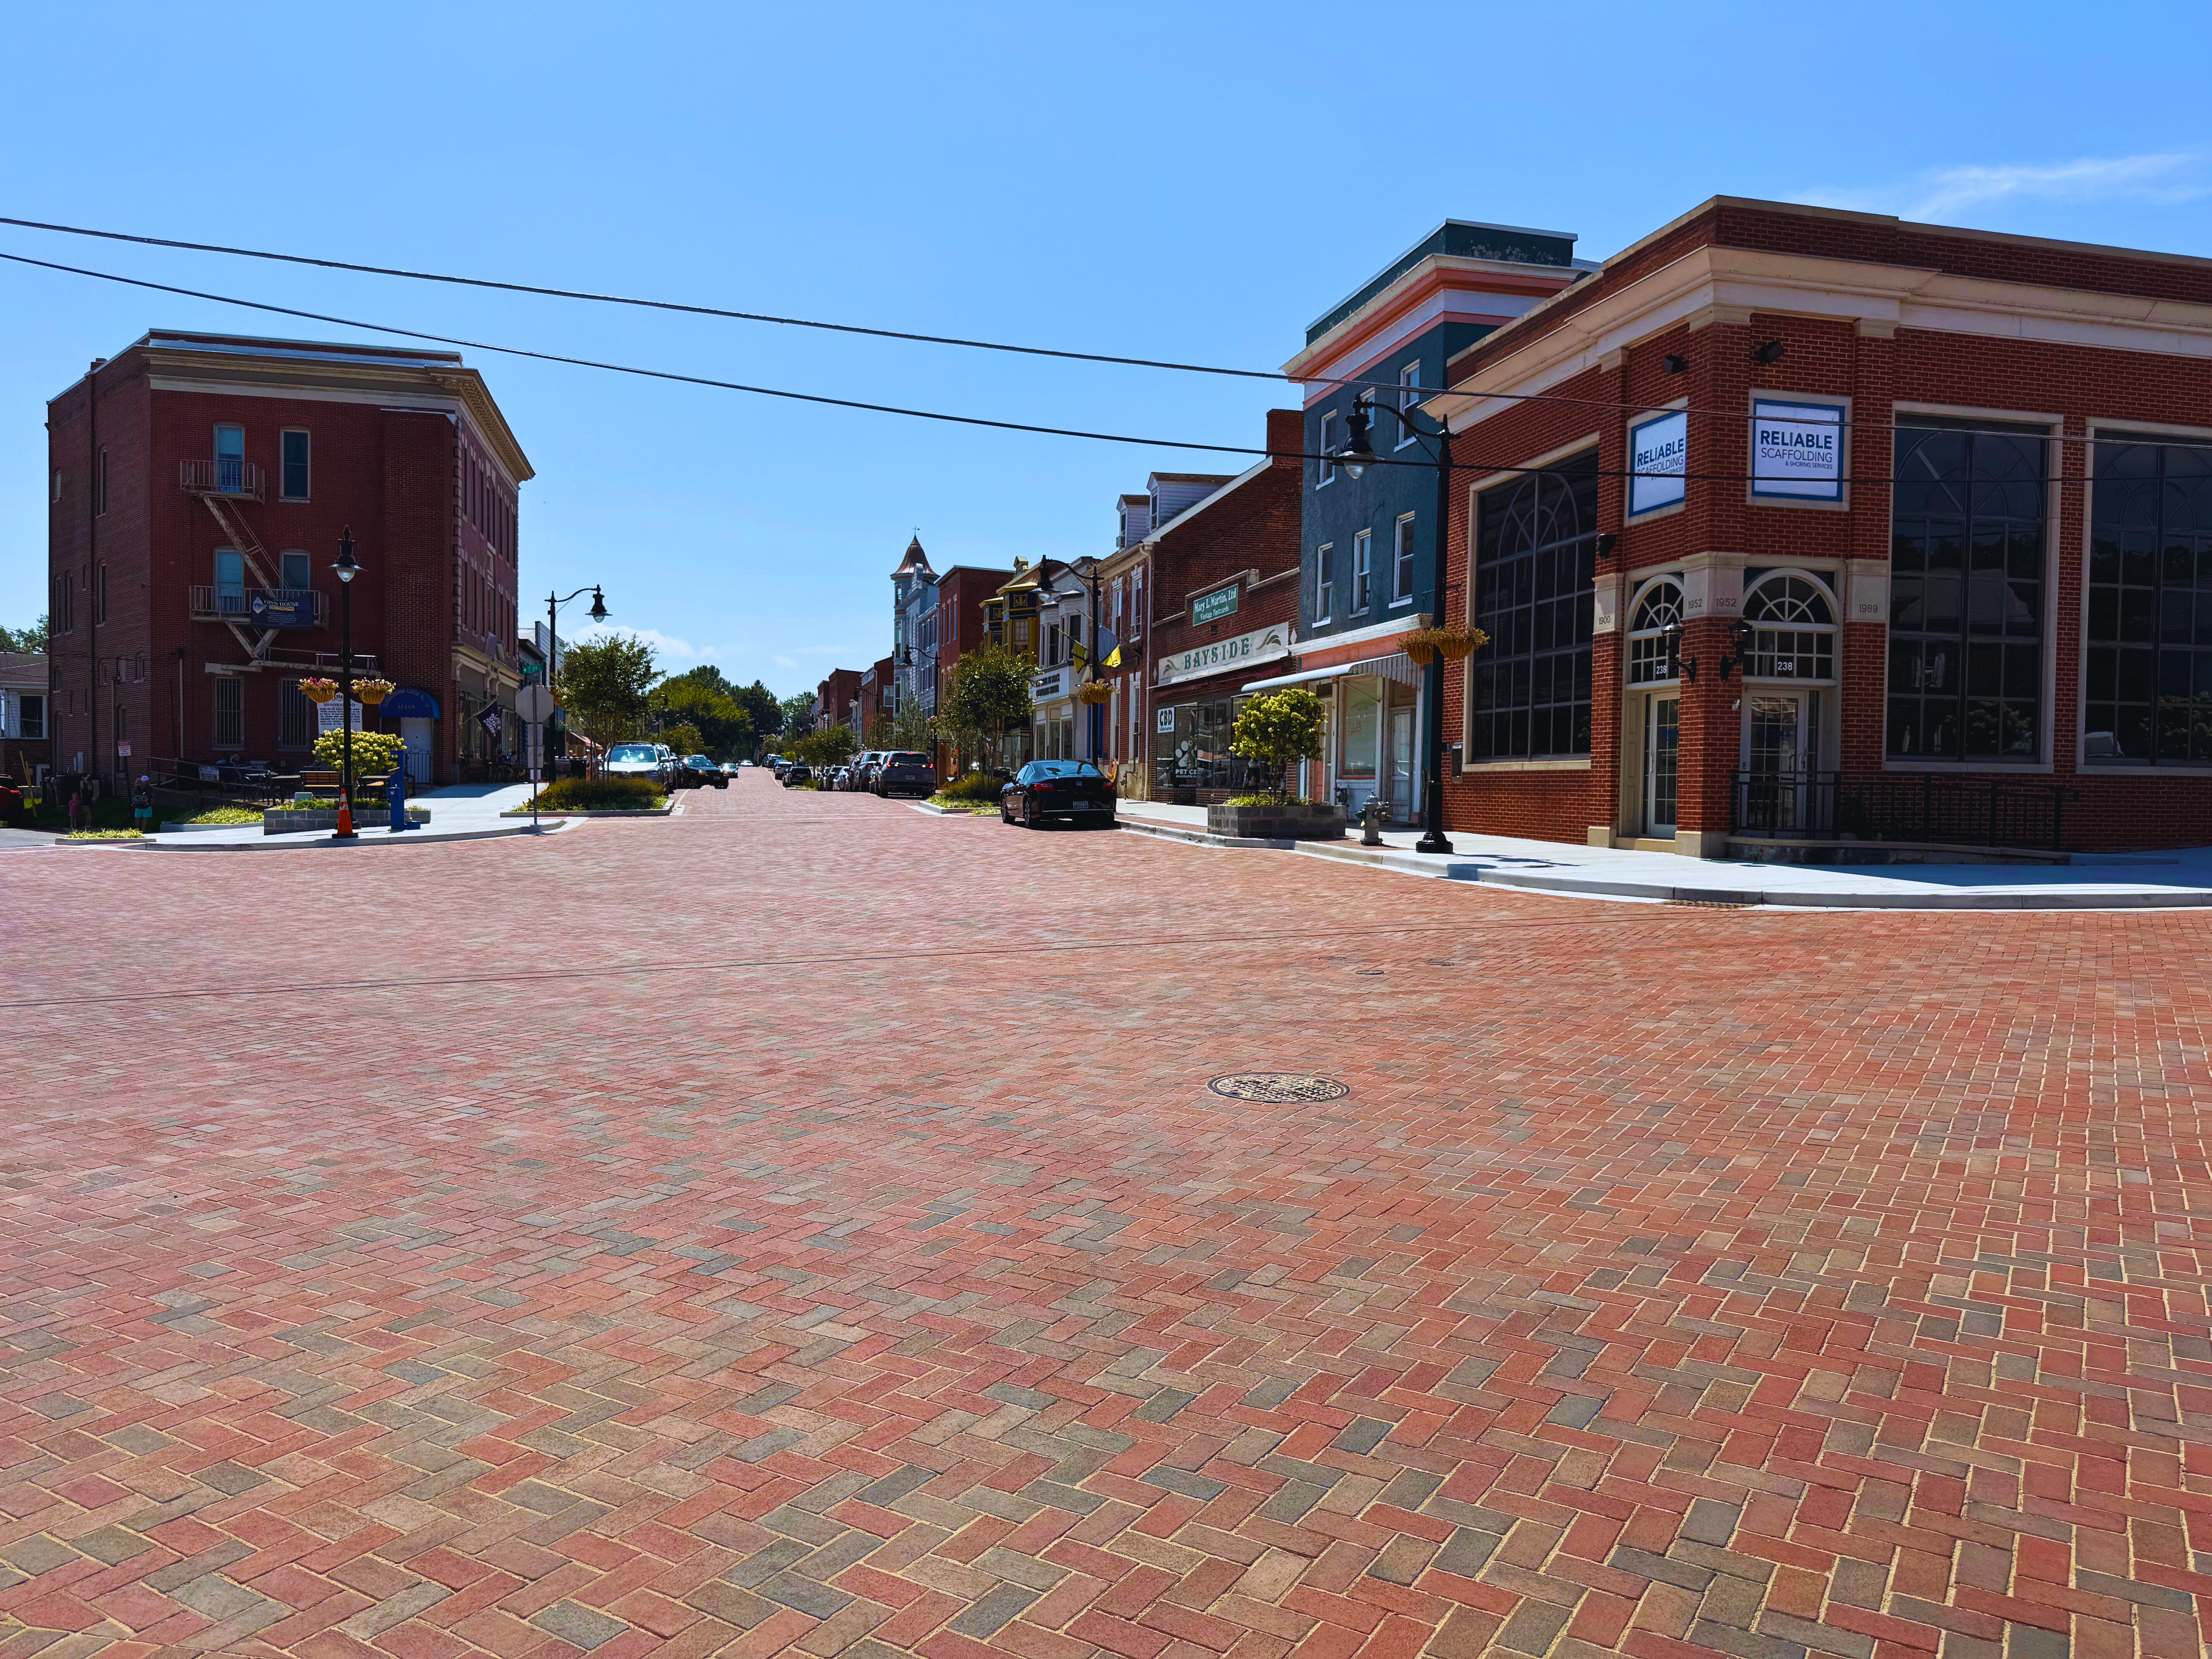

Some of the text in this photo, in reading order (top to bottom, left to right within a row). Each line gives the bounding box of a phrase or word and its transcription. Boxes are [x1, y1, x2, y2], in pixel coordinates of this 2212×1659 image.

[1760, 430, 1832, 449] RELIABLE
[1637, 438, 1684, 467] RELIABLE
[1761, 448, 1832, 462] SCAFFOLDING
[1194, 602, 1205, 613] Mary
[1228, 587, 1237, 600] Ltd
[1688, 599, 1702, 609] 1952
[1716, 598, 1736, 607] 1952
[1860, 604, 1878, 613] 1989
[1599, 616, 1610, 625] 1900
[1184, 637, 1249, 670] BAYSIDE
[1656, 665, 1667, 674] 238
[1778, 661, 1793, 671] 238
[407, 688, 421, 697] LODGE
[1160, 710, 1173, 726] CBD
